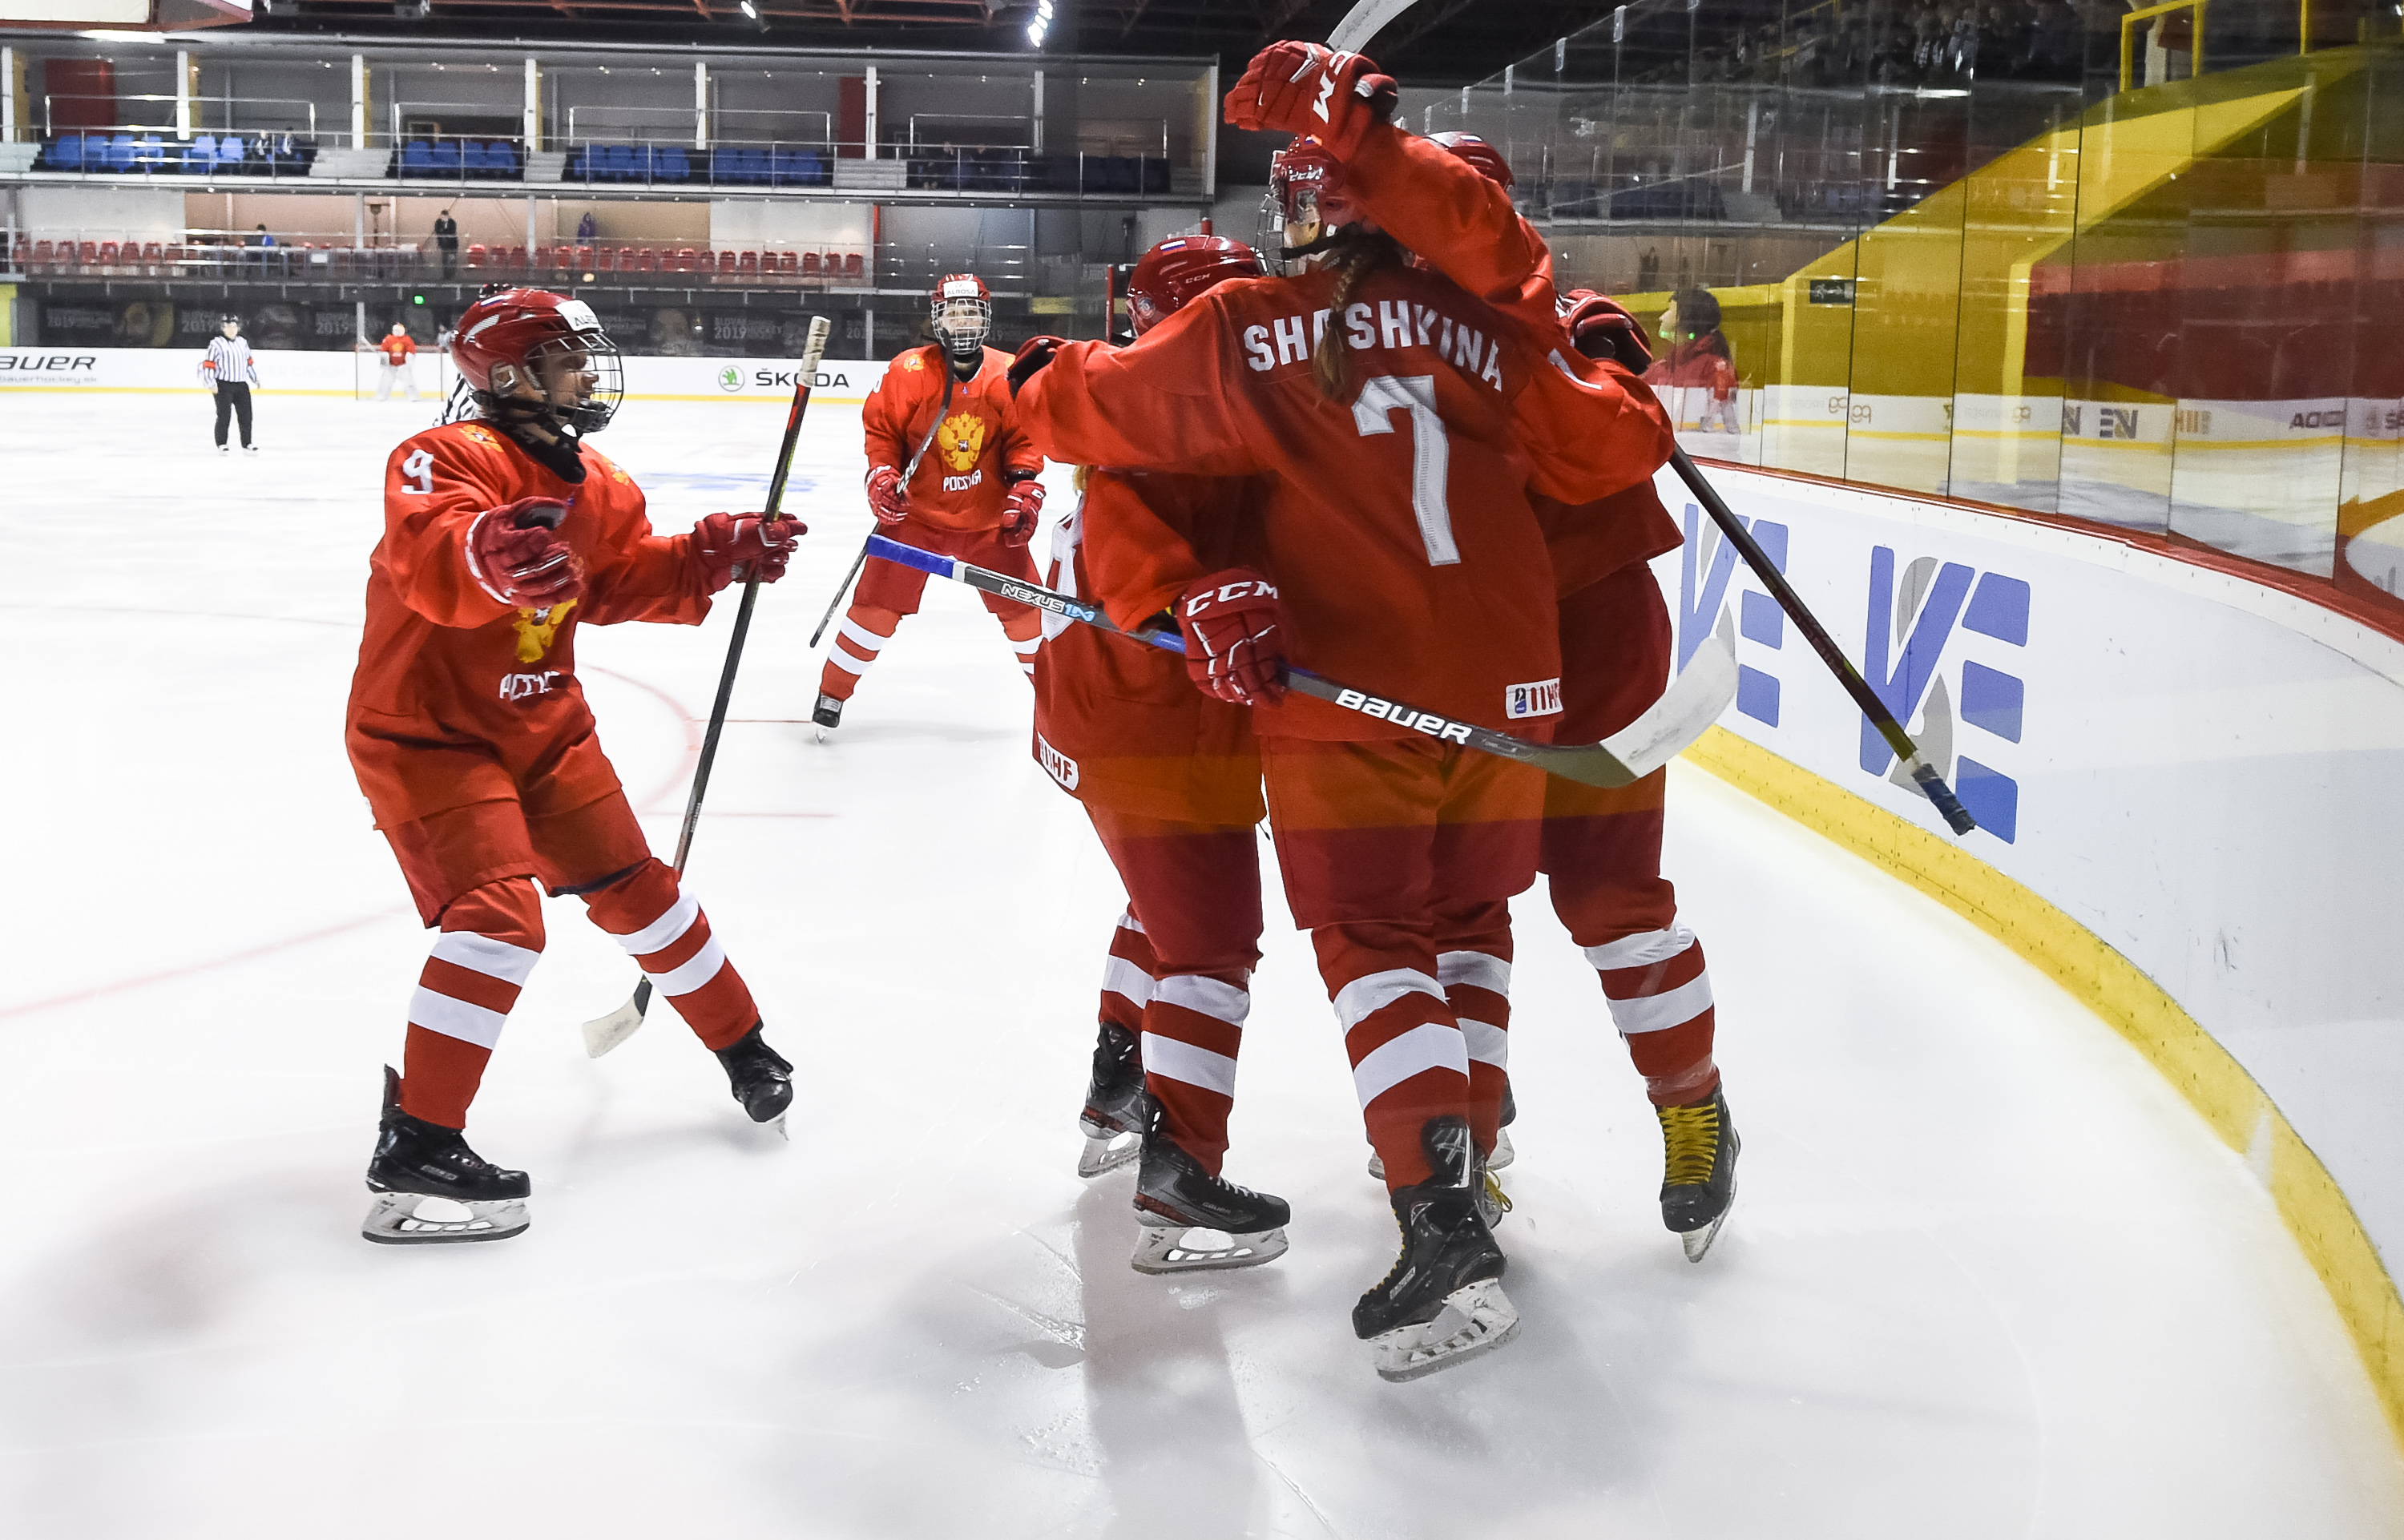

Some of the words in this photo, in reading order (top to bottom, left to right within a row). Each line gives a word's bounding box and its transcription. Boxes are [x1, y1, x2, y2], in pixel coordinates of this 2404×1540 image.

[1185, 273, 1211, 284] CCM
[714, 325, 747, 340] 2019
[401, 449, 434, 494] 9
[1350, 374, 1462, 566] 7
[1001, 583, 1066, 613] NEXUS
[1186, 580, 1278, 617] CCM
